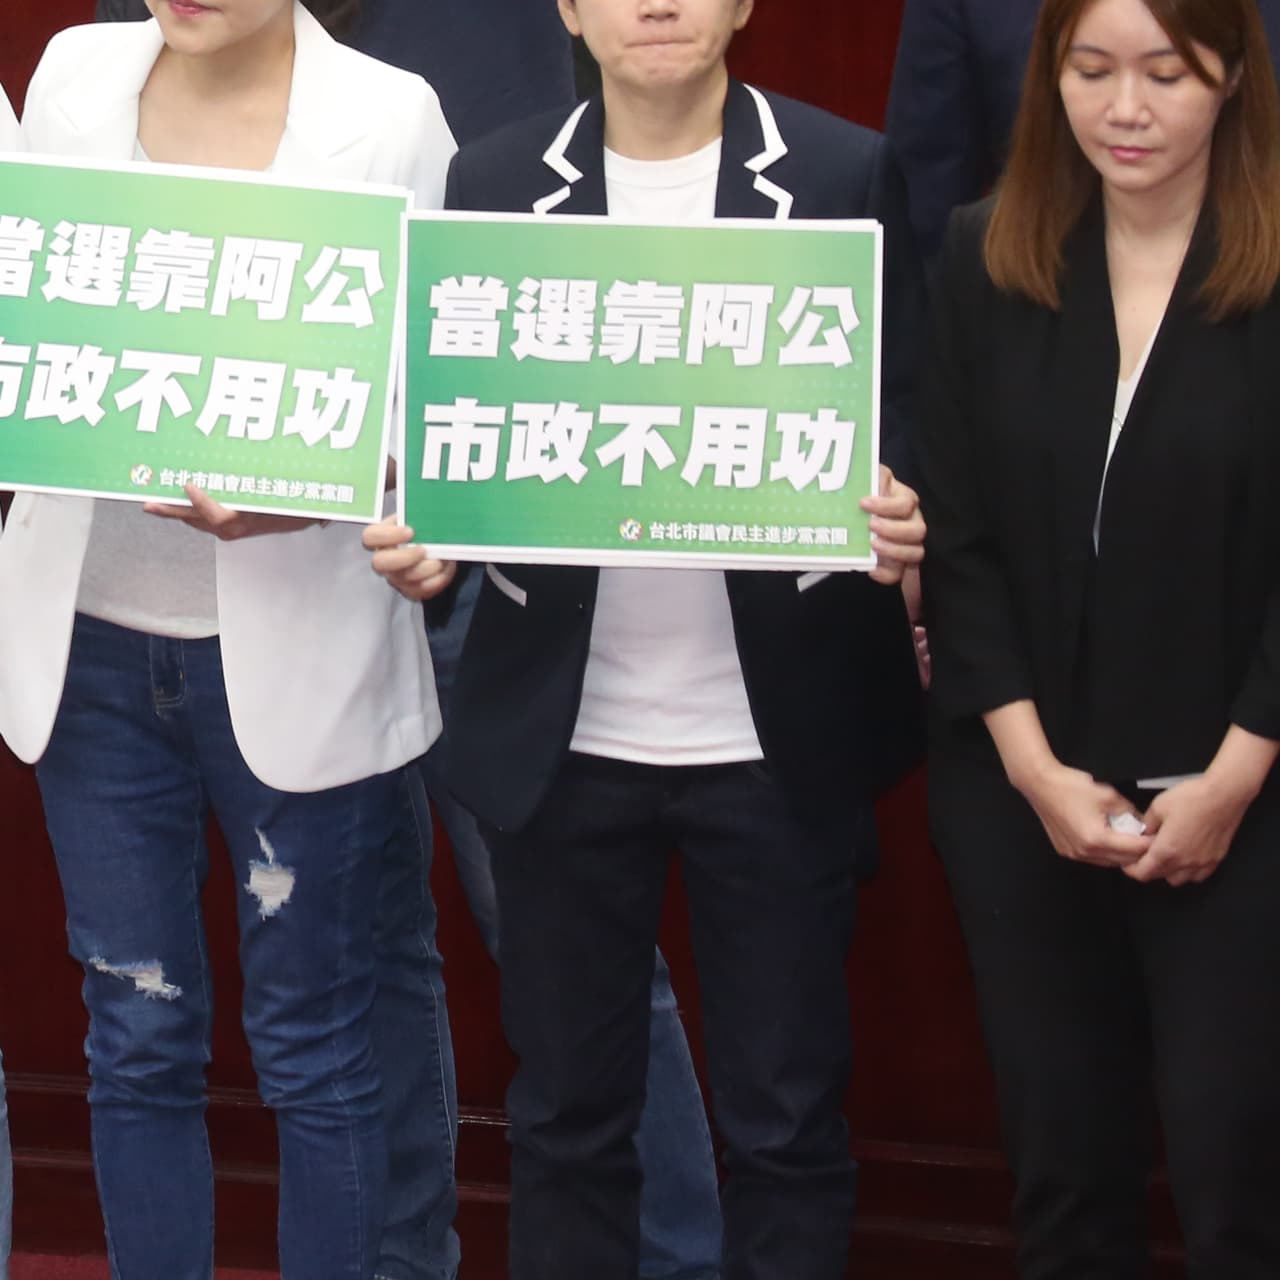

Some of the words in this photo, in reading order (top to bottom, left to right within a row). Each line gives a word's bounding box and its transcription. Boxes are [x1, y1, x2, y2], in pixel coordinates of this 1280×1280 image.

[429, 275, 861, 368] 當選靠阿公
[421, 397, 857, 493] 市政不用功
[159, 470, 356, 503] 台北市議會民主進步黨黨團
[650, 523, 849, 545] 台北市議會民主進步黨黨團
